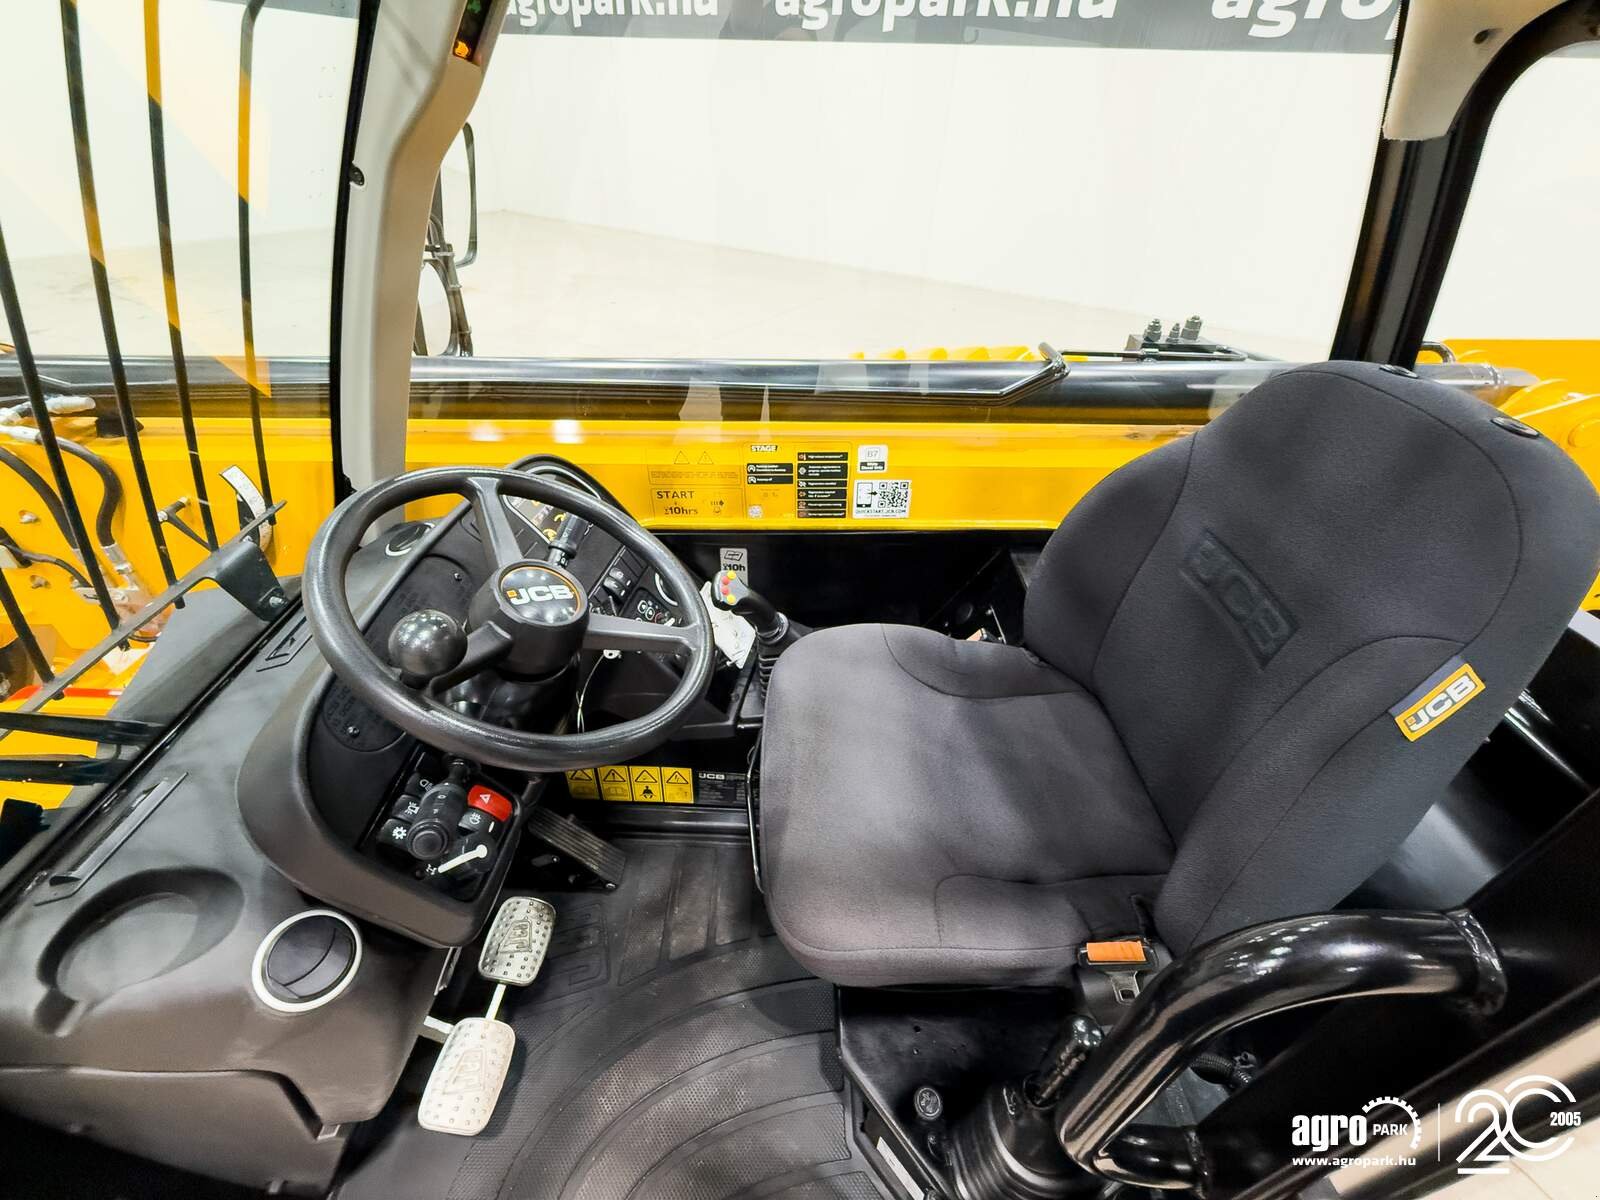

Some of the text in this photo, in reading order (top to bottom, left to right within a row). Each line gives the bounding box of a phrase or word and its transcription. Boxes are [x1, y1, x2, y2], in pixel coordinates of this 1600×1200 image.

[656, 490, 695, 499] START
[507, 584, 575, 606] JCB
[1405, 674, 1477, 731] JCB
[698, 772, 726, 780] JCB
